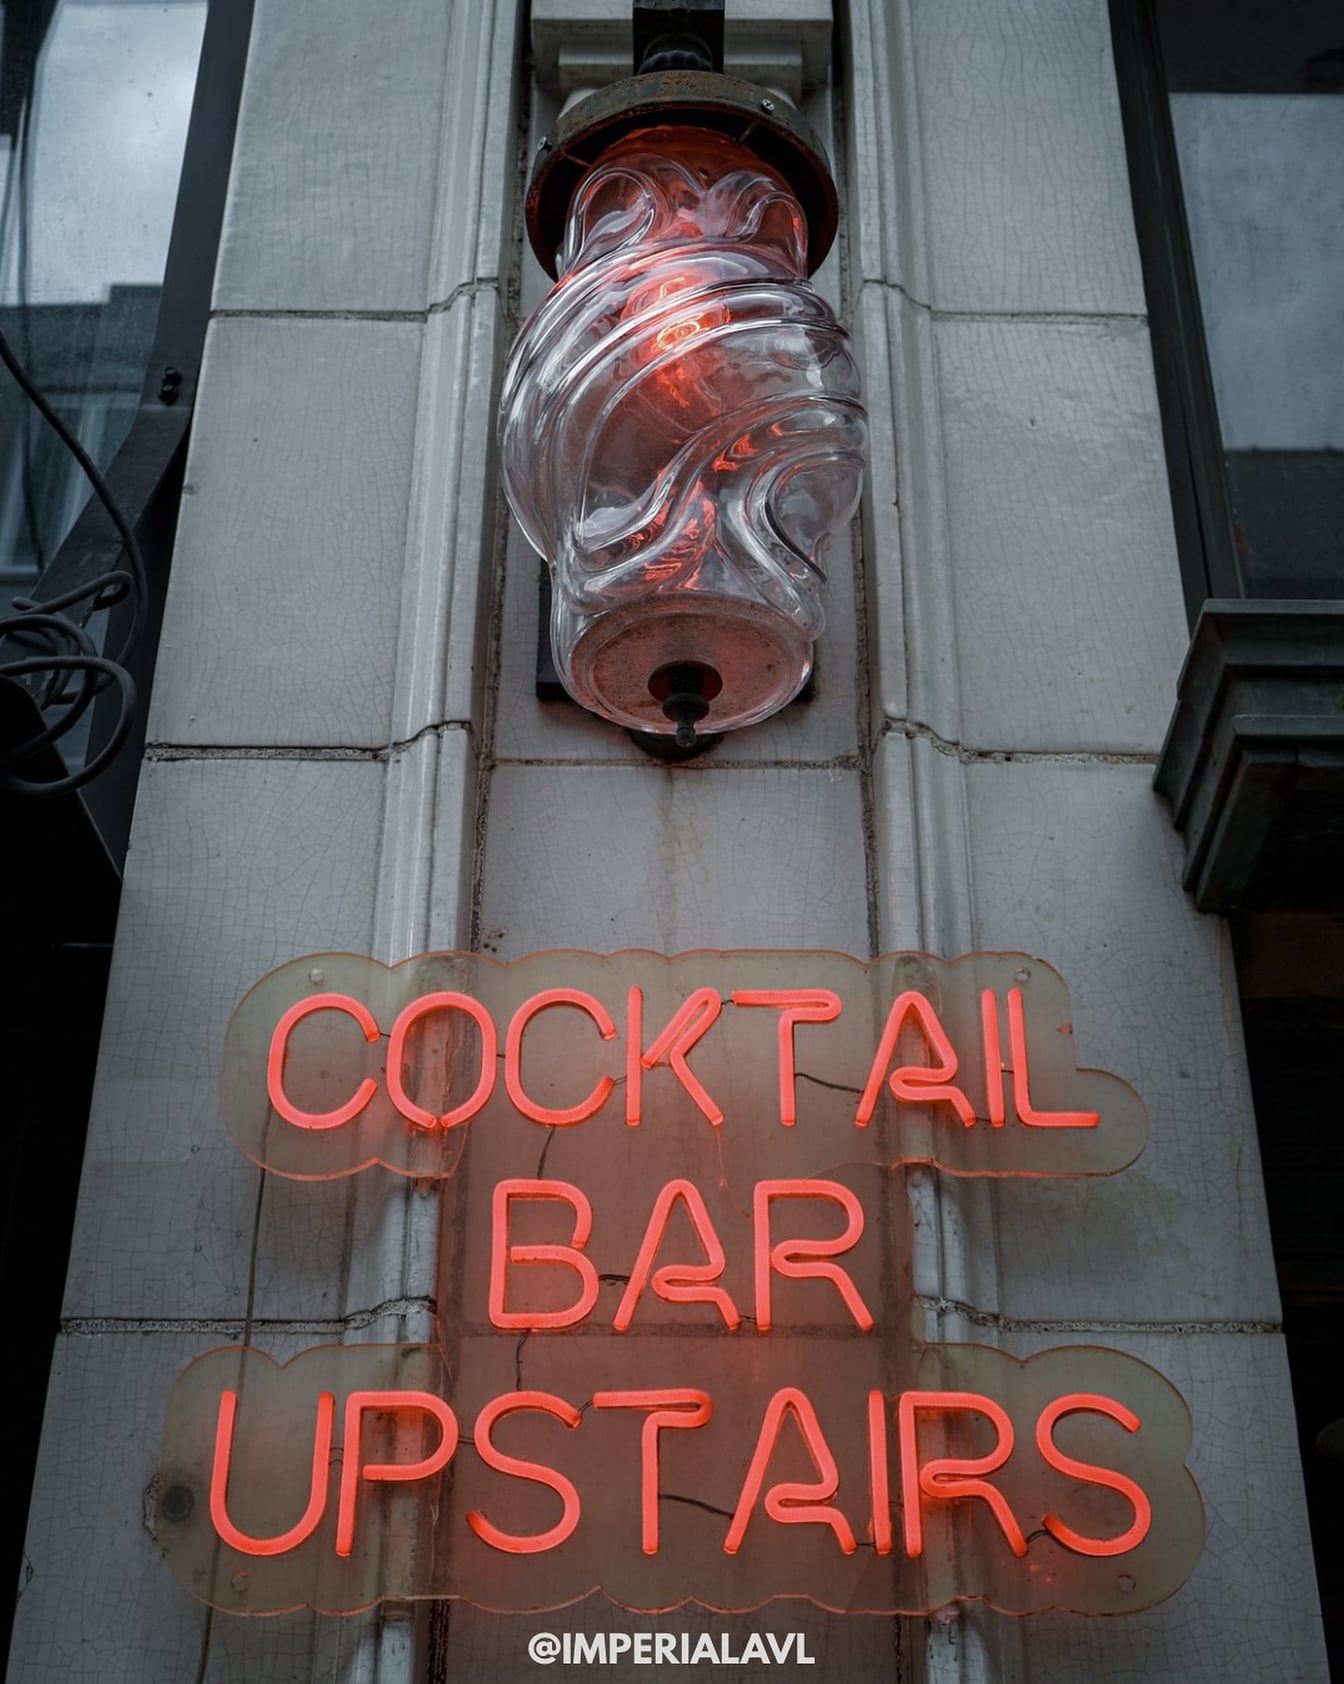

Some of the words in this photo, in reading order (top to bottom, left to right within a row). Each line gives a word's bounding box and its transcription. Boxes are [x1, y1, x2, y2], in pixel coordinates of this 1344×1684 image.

[266, 986, 1099, 1131] COCKTAIL
[488, 1178, 873, 1332] BAR
[210, 1387, 1152, 1557] UPSTAIRS
